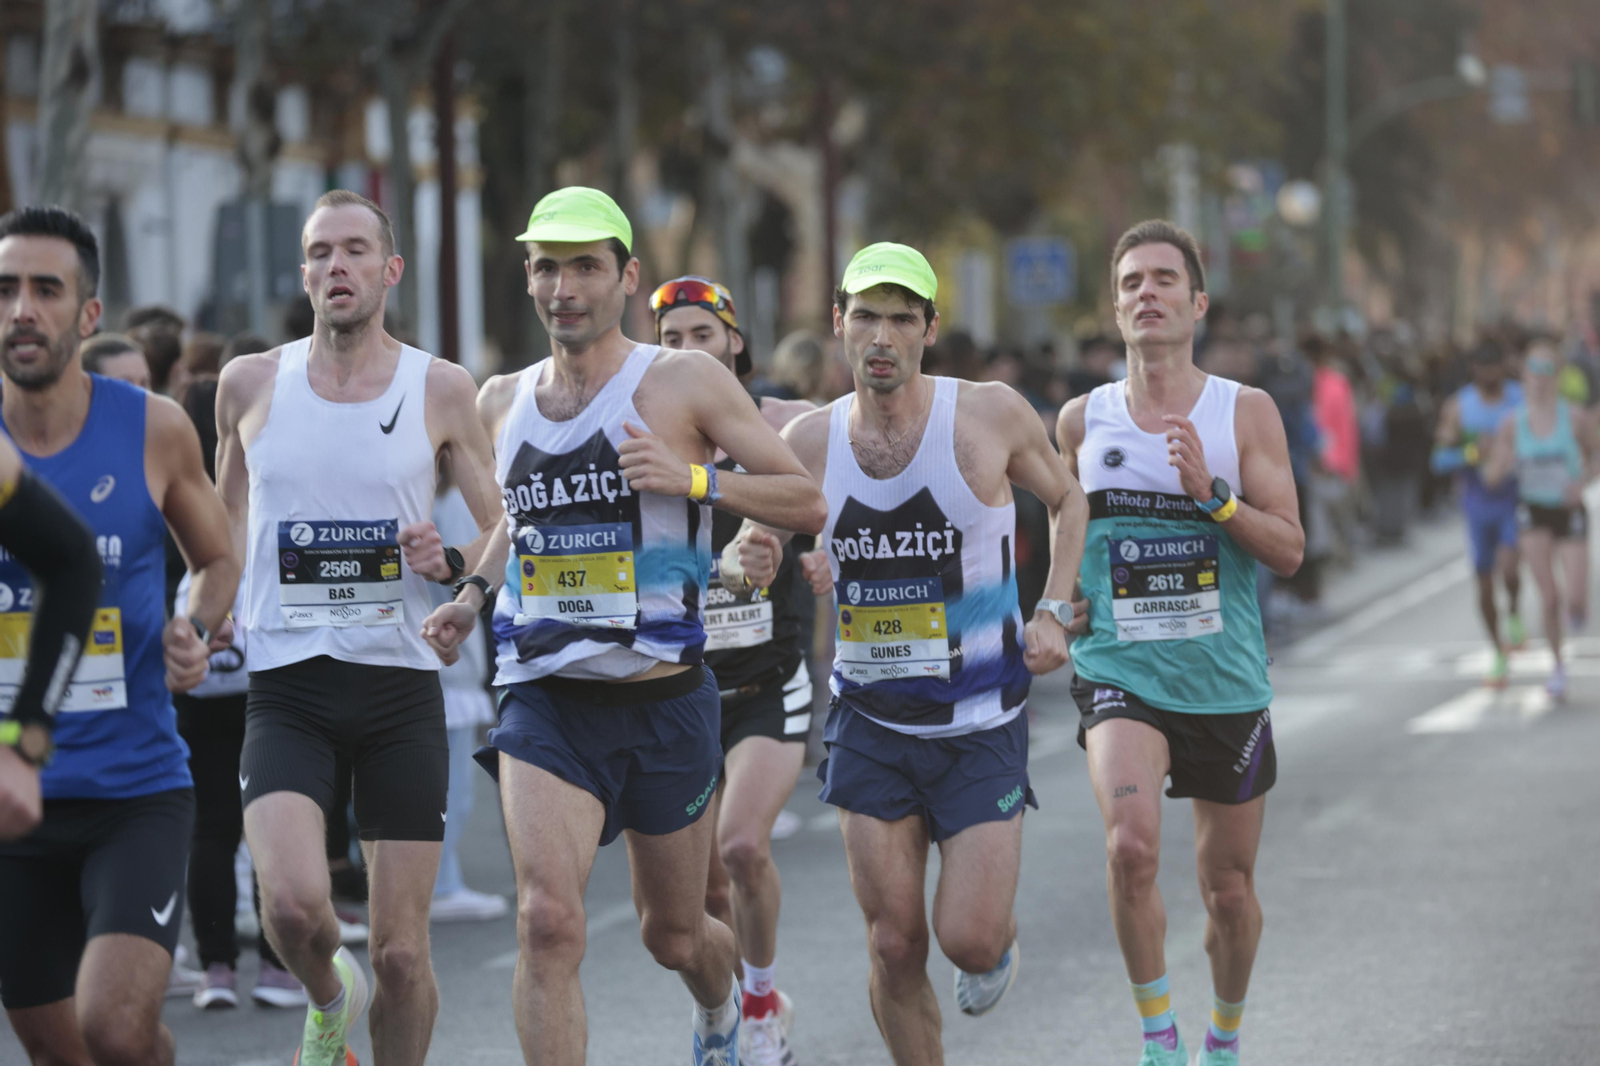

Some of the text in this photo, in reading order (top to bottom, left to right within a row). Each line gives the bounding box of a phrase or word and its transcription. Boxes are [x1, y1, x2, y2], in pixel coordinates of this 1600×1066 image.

[1105, 490, 1198, 512] Peñota Dental
[318, 526, 386, 542] ZURICH
[547, 531, 617, 550] ZURICH
[831, 521, 955, 563] BOĞAZİÇİ
[1143, 540, 1205, 558] ZURICH
[319, 560, 361, 578] 2560
[557, 570, 587, 588] 437
[1147, 573, 1185, 591] 2612
[328, 587, 355, 601] BAS
[864, 585, 929, 602] ZURICH
[557, 599, 595, 613] DOGA
[1133, 597, 1202, 614] CARRASCAL
[727, 607, 762, 624] ALERT
[873, 619, 902, 636] 428
[870, 644, 911, 659] GUNES
[996, 784, 1023, 813] SOAR
